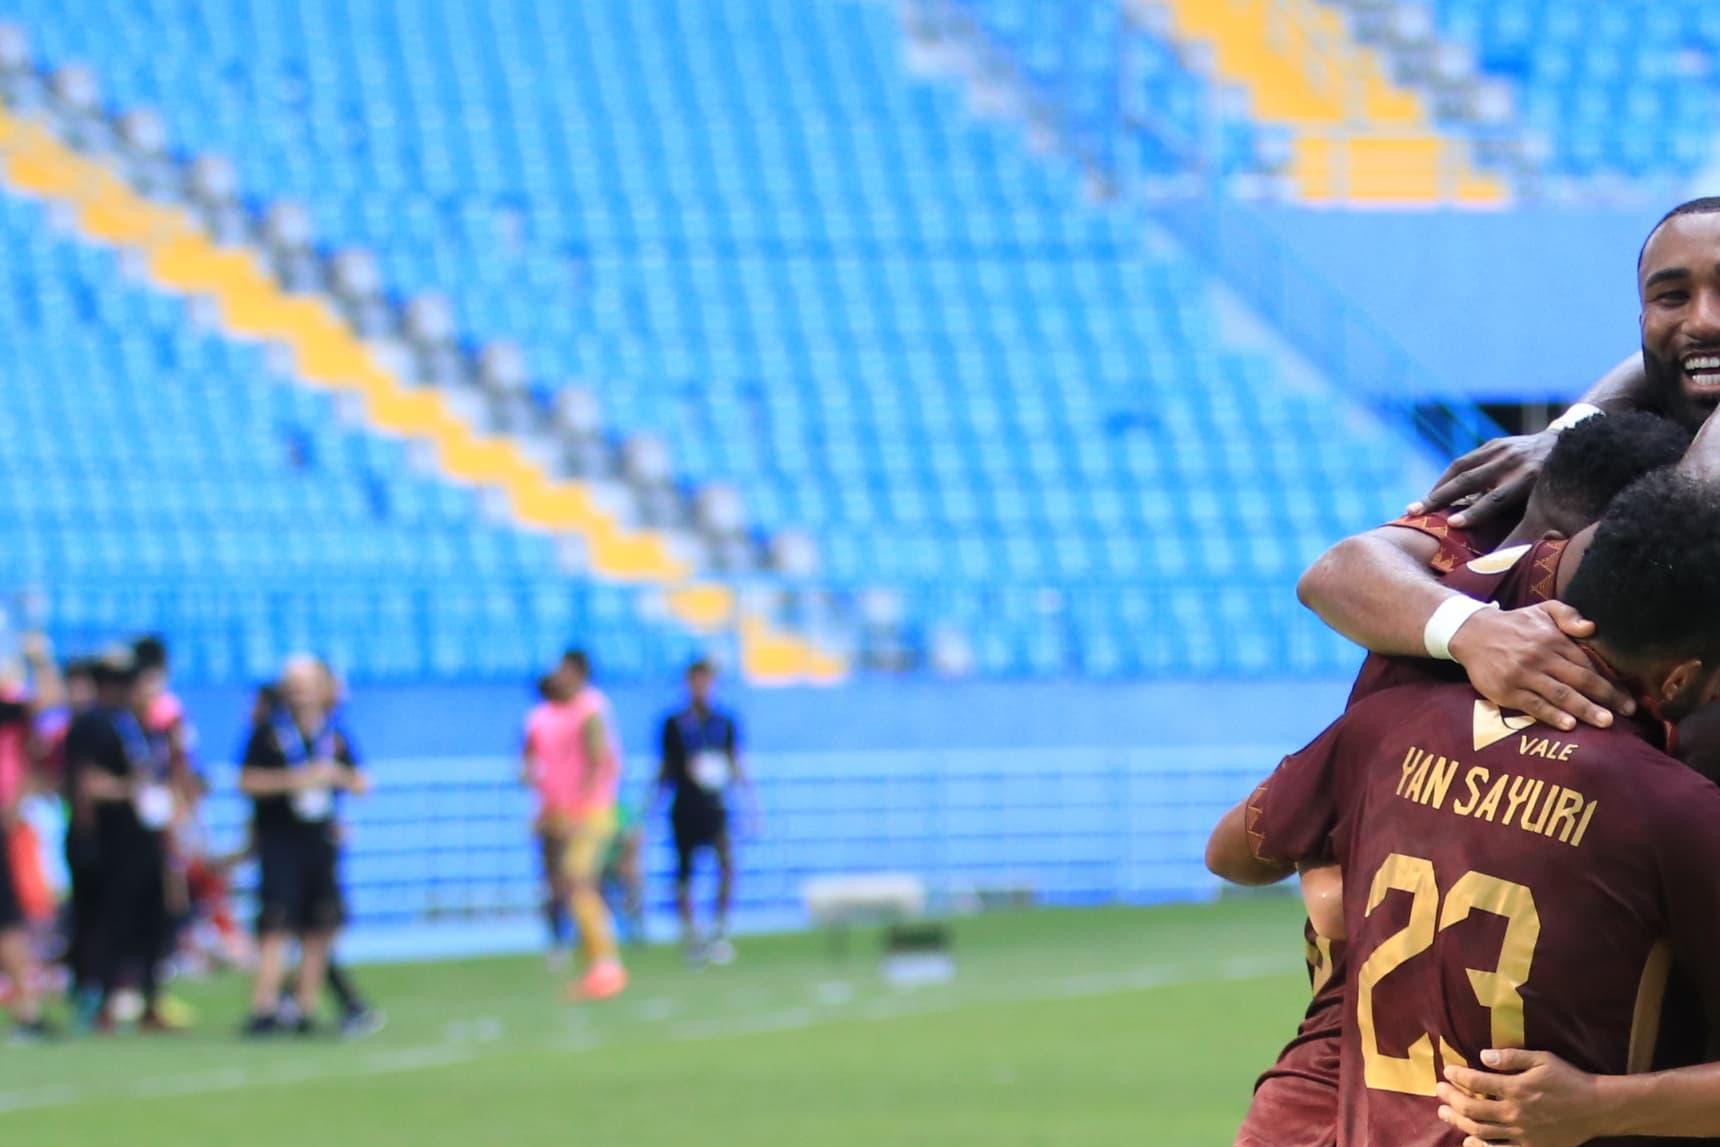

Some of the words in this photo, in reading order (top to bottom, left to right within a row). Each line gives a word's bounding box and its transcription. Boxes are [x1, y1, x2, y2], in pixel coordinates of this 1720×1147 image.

[1396, 746, 1459, 809] YAN
[1453, 766, 1598, 847] SAYURI
[1519, 735, 1578, 761] VALE
[1357, 853, 1541, 1097] 23
